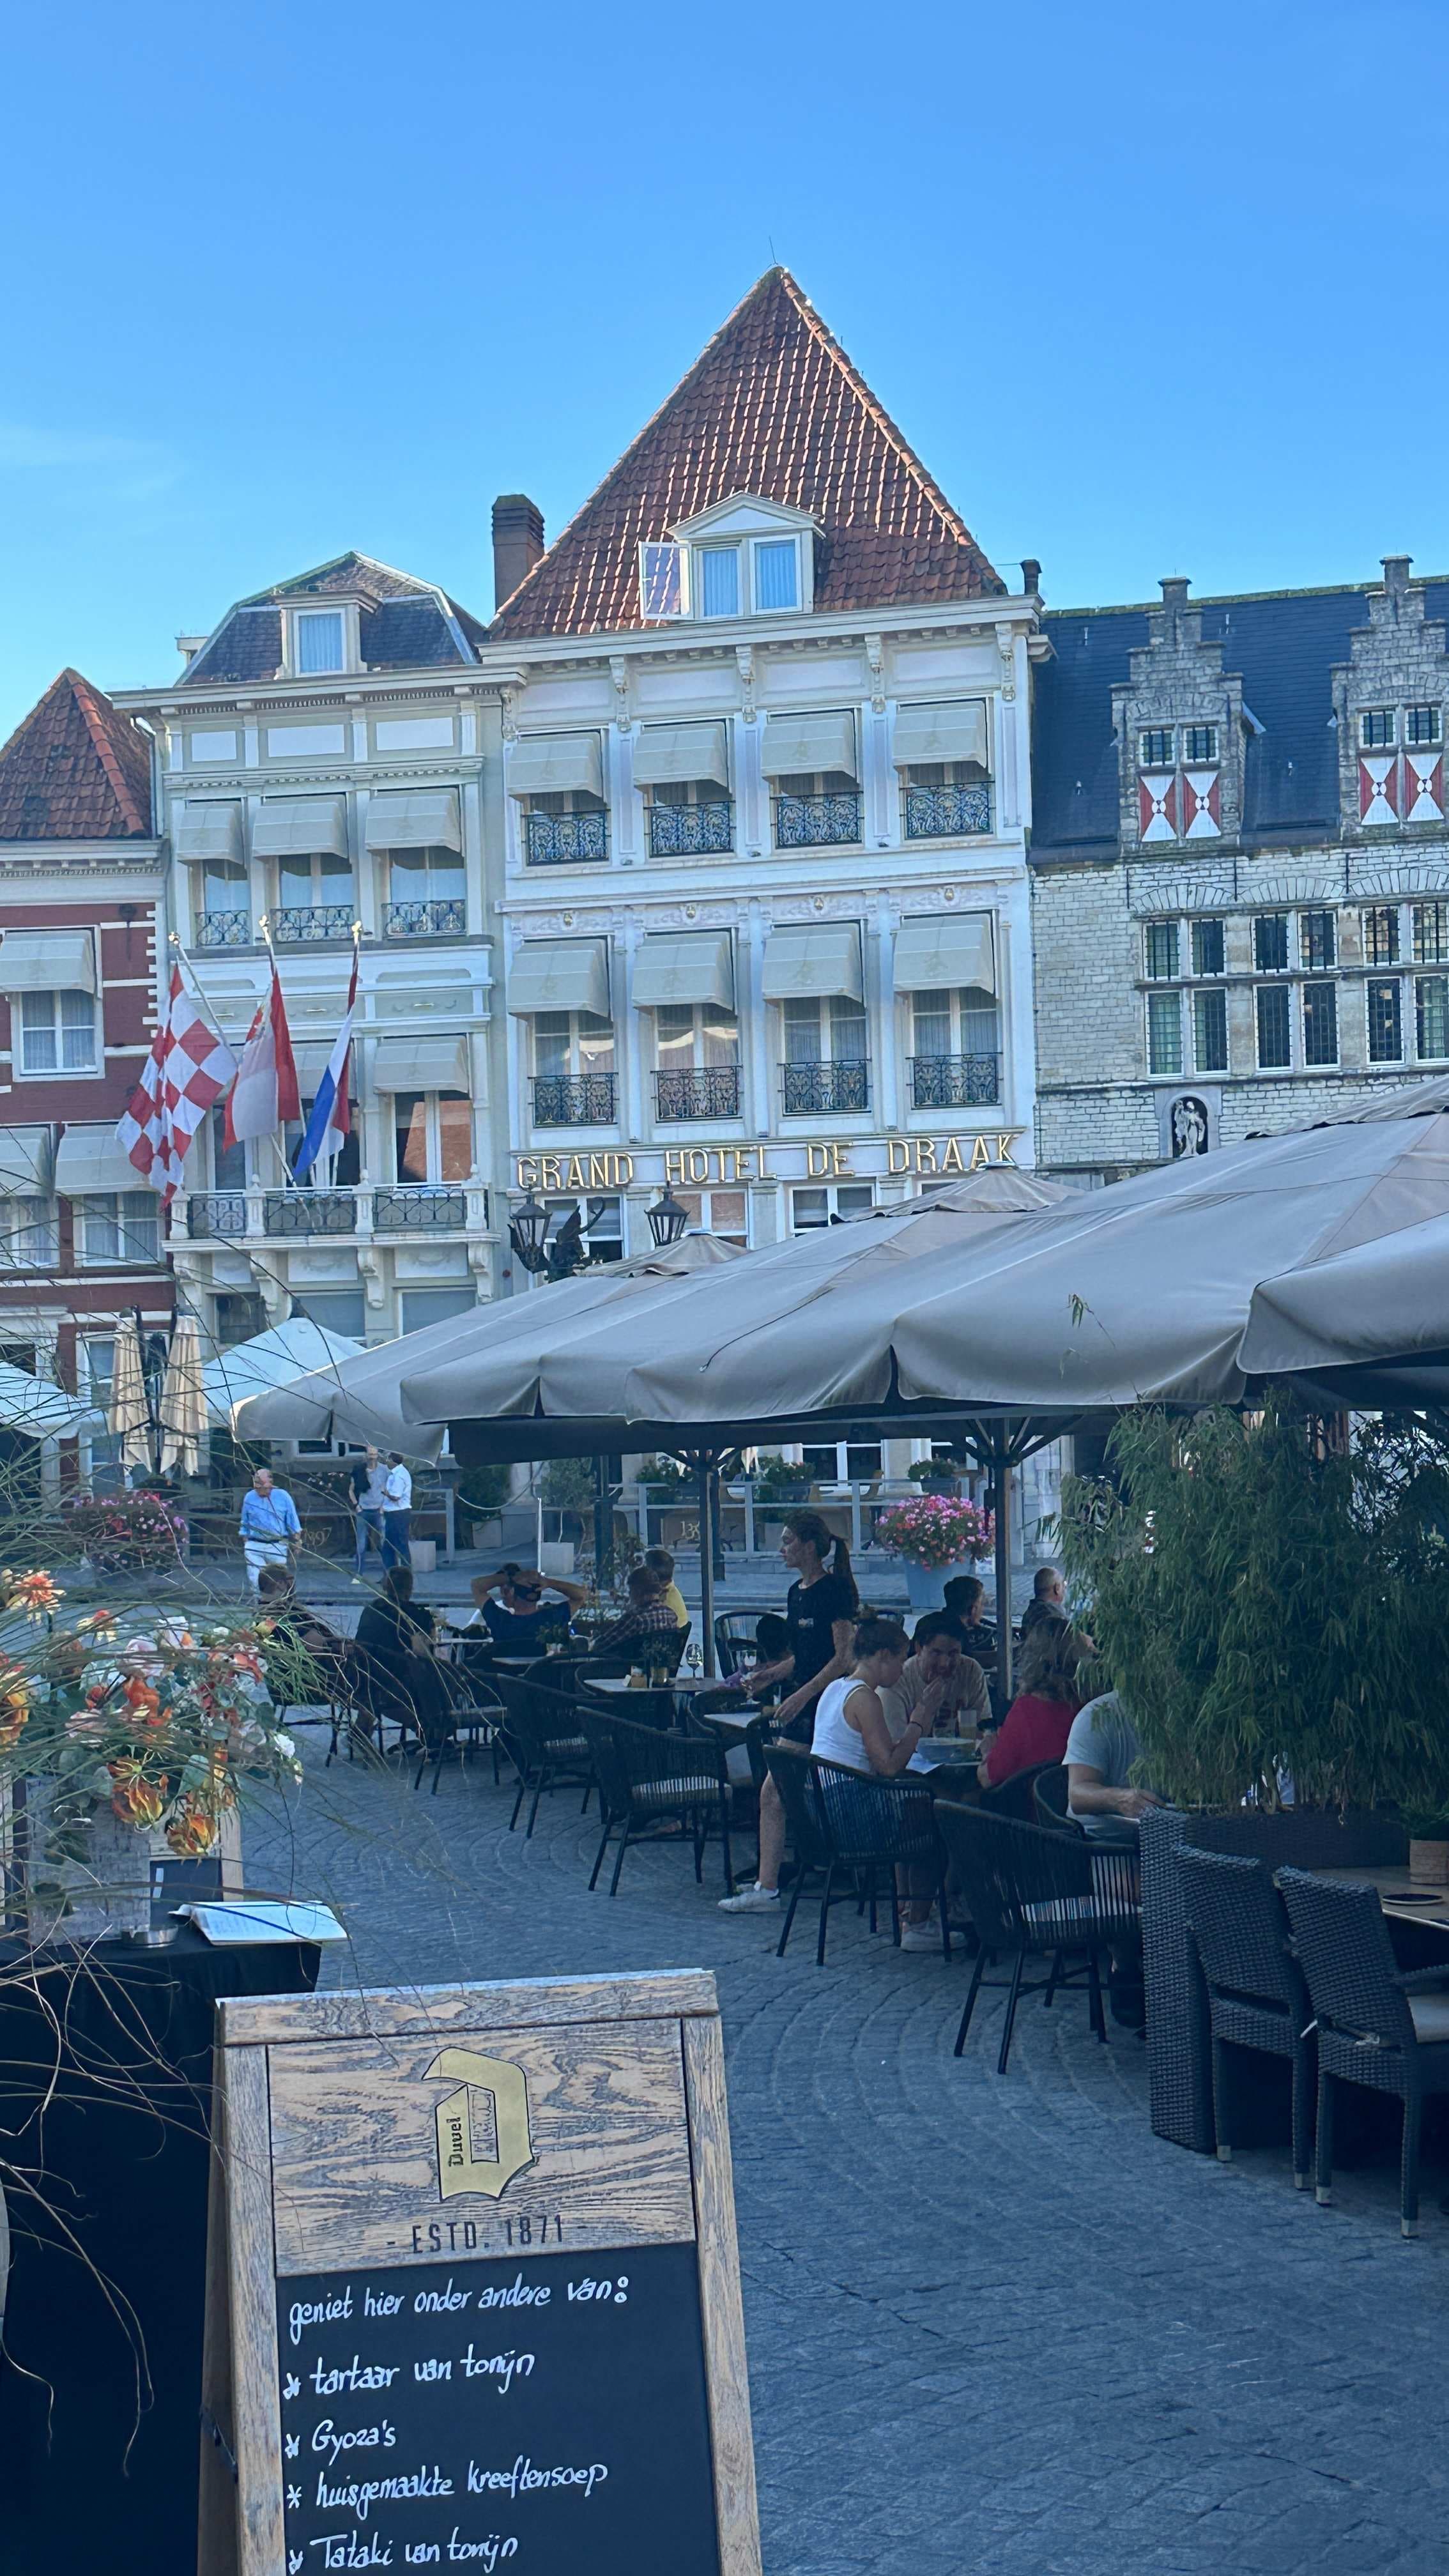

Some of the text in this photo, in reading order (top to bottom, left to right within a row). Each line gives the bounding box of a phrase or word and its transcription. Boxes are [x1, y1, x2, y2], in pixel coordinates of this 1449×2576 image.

[517, 1133, 1015, 1190] GRAND HOTEL DE DRAAK
[446, 2117, 464, 2167] Duvel
[412, 2214, 563, 2253] ESTD. 1871
[289, 2285, 353, 2346] geniet
[364, 2287, 406, 2317] hier
[413, 2277, 473, 2313] onder
[477, 2272, 551, 2309] andere
[309, 2354, 401, 2395] tartaar
[413, 2358, 452, 2382] van
[310, 2419, 397, 2466] Gyoza's
[315, 2454, 609, 2521] huisgemaakte kreeftensoep
[309, 2529, 394, 2570] Tataki
[404, 2539, 441, 2564] van
